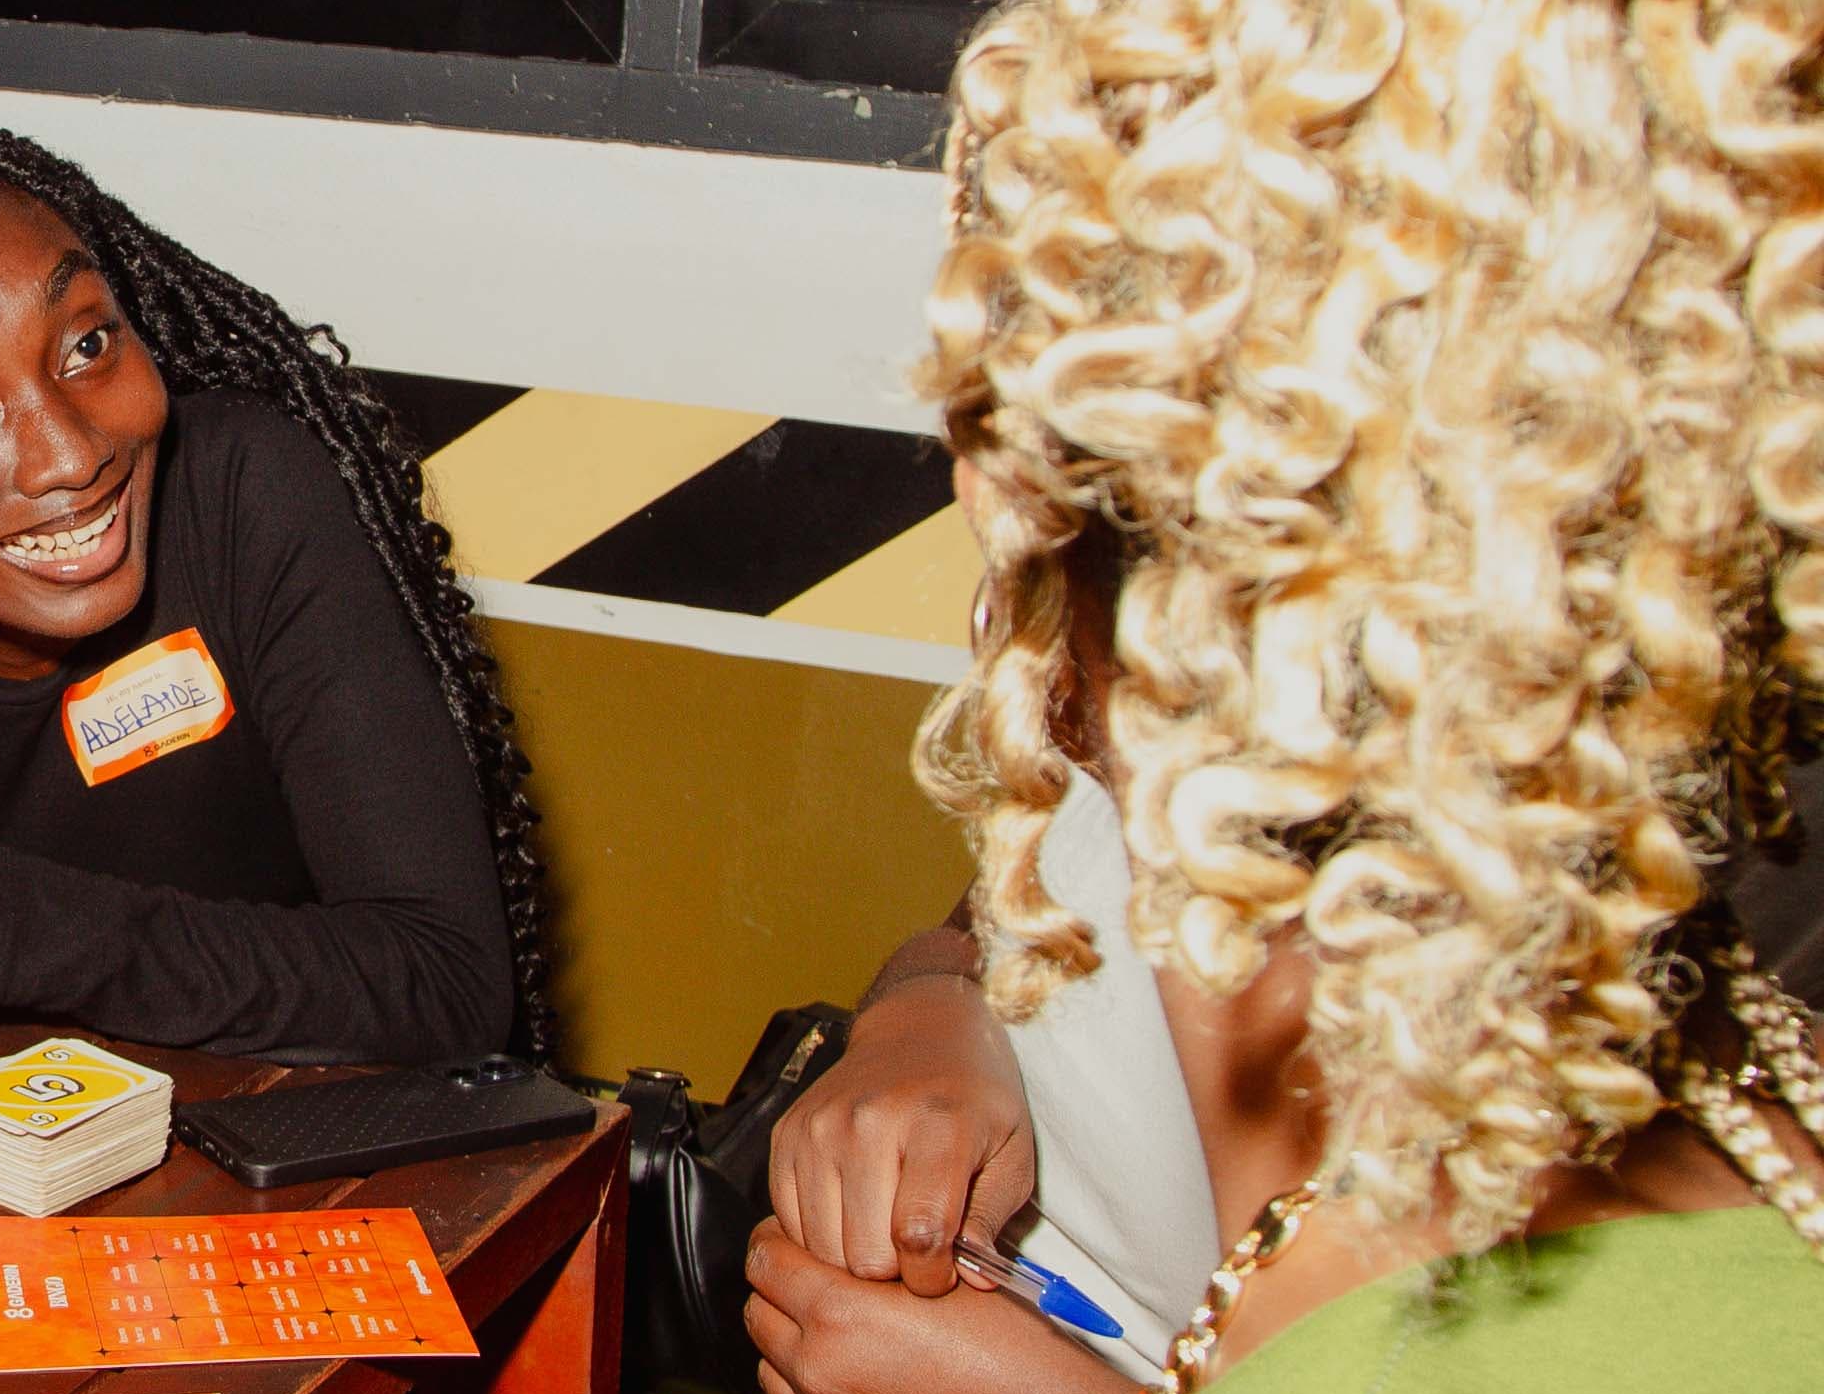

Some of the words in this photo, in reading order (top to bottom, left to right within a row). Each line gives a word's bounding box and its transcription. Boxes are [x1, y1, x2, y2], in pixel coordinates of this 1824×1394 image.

[80, 679, 207, 754] ADELAIDE
[10, 1073, 86, 1102] 5
[6, 1263, 28, 1307] GADERIN
